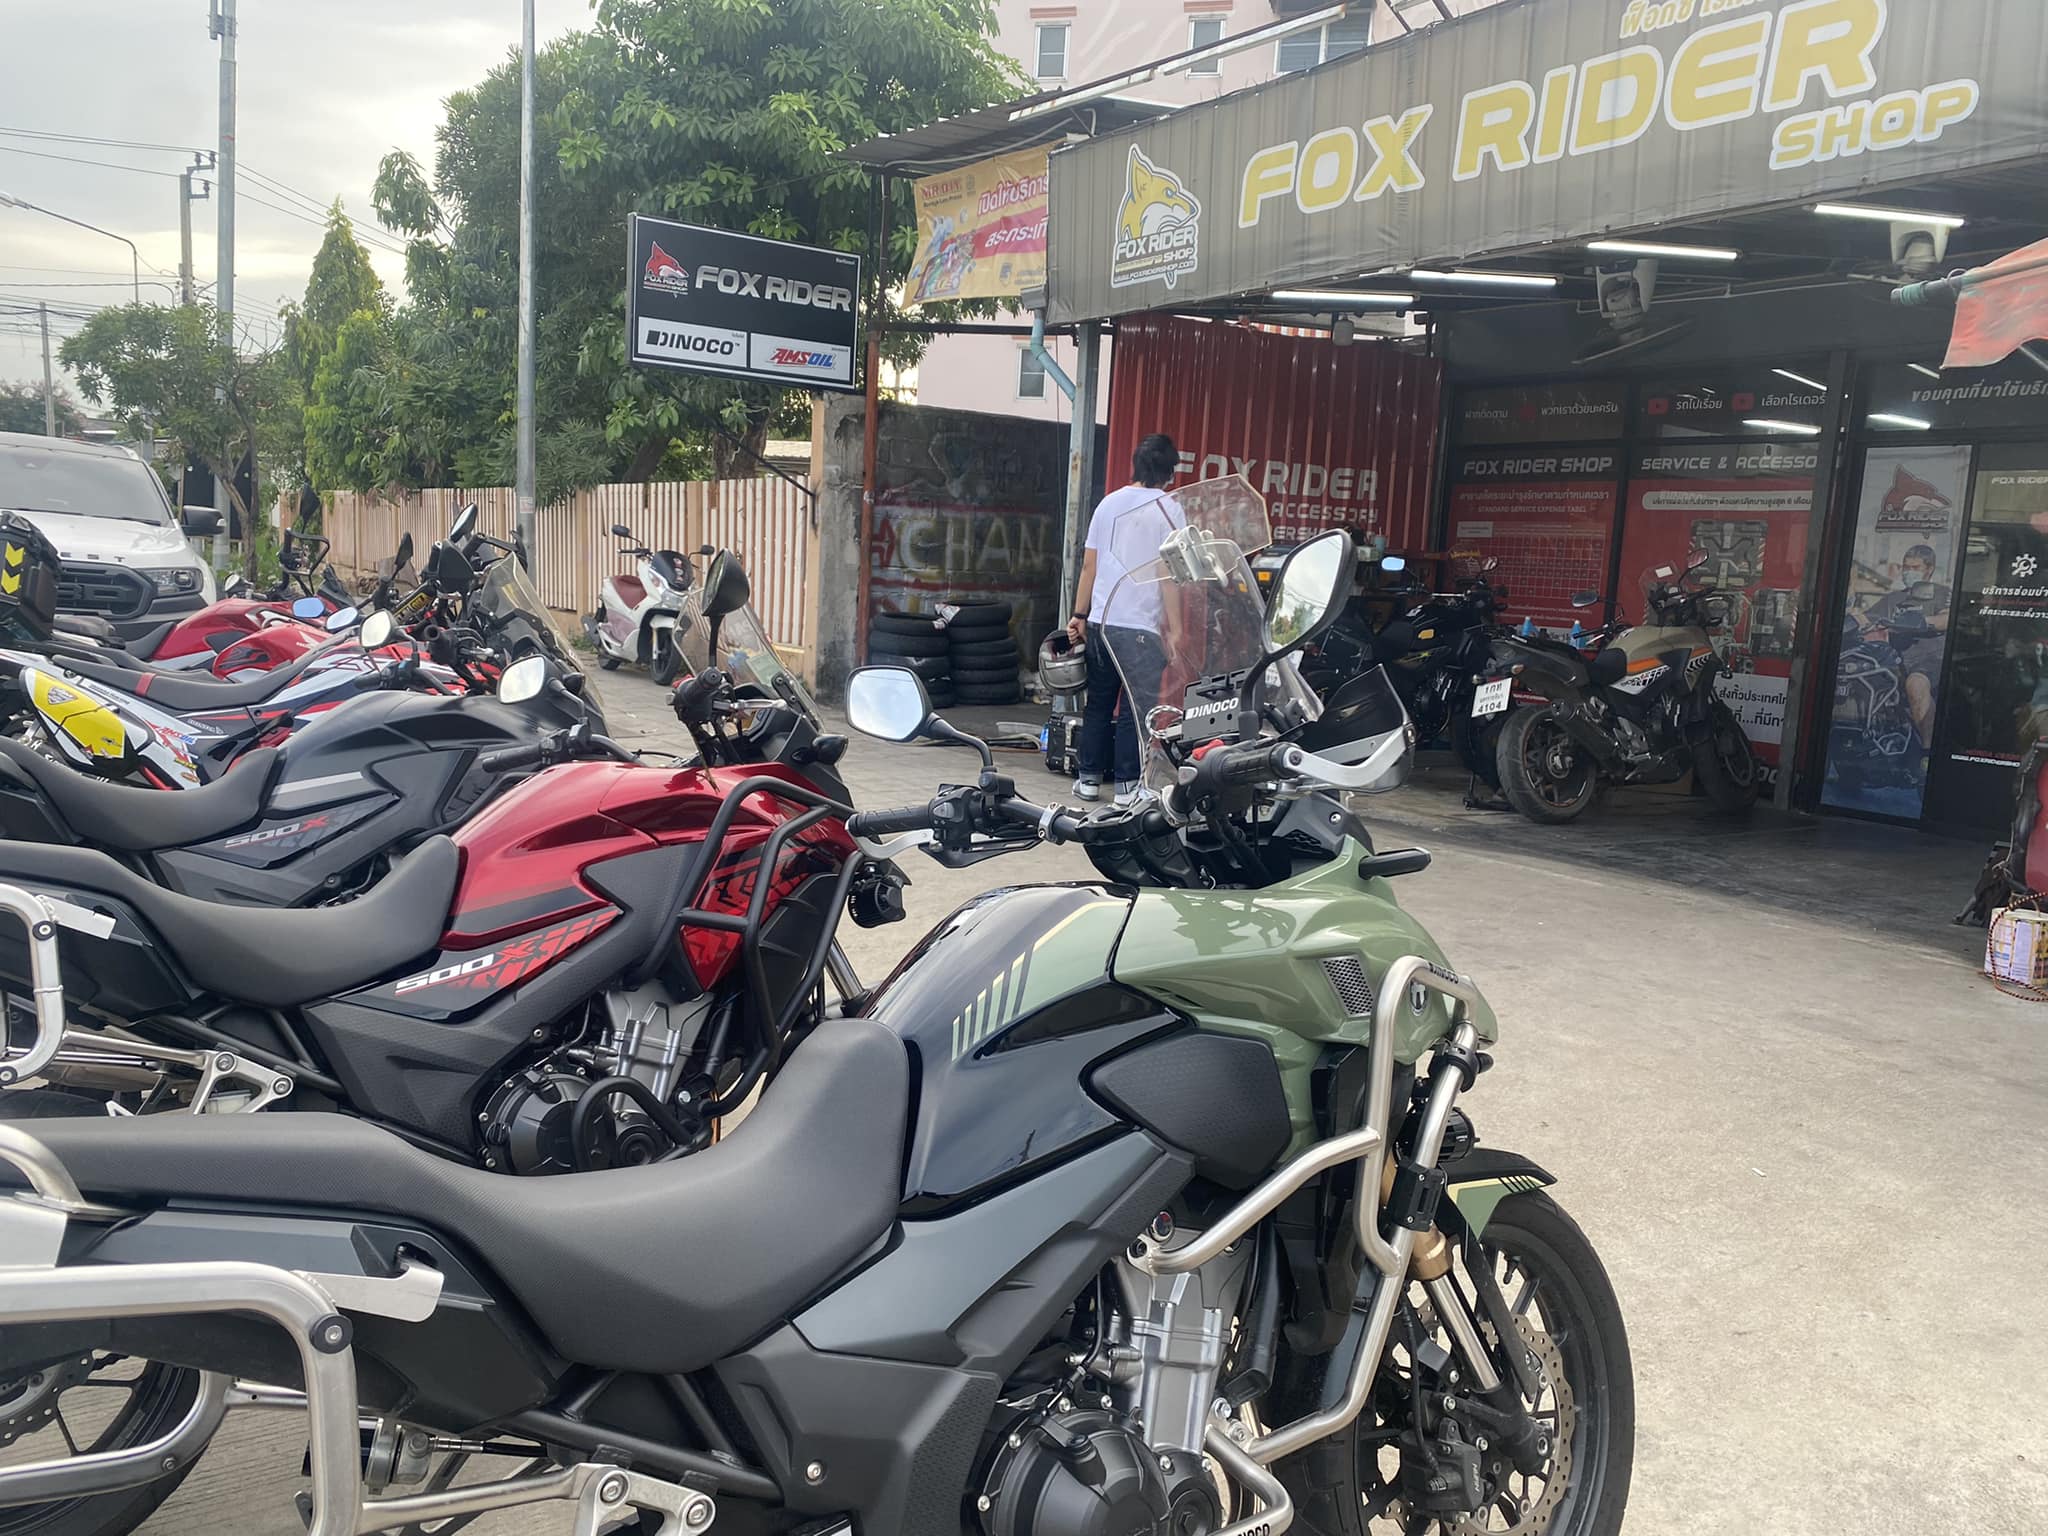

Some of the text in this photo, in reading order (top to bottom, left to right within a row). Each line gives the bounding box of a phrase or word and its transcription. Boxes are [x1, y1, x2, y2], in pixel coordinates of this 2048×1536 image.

[1239, 0, 1887, 228] FOX RIDER
[1769, 79, 1978, 170] SHOP
[1116, 225, 1195, 261] FOX RIDER
[1163, 247, 1194, 262] SHOP
[695, 265, 852, 312] FOX RIDER
[646, 330, 734, 356] DINOCO
[769, 347, 834, 368] AMSOIL
[1464, 457, 1613, 475] FOX RIDER SHOP
[1641, 455, 1818, 470] SERVICE & ACCESSO
[1262, 461, 1378, 500] RIDER
[1185, 697, 1239, 720] DINOCO
